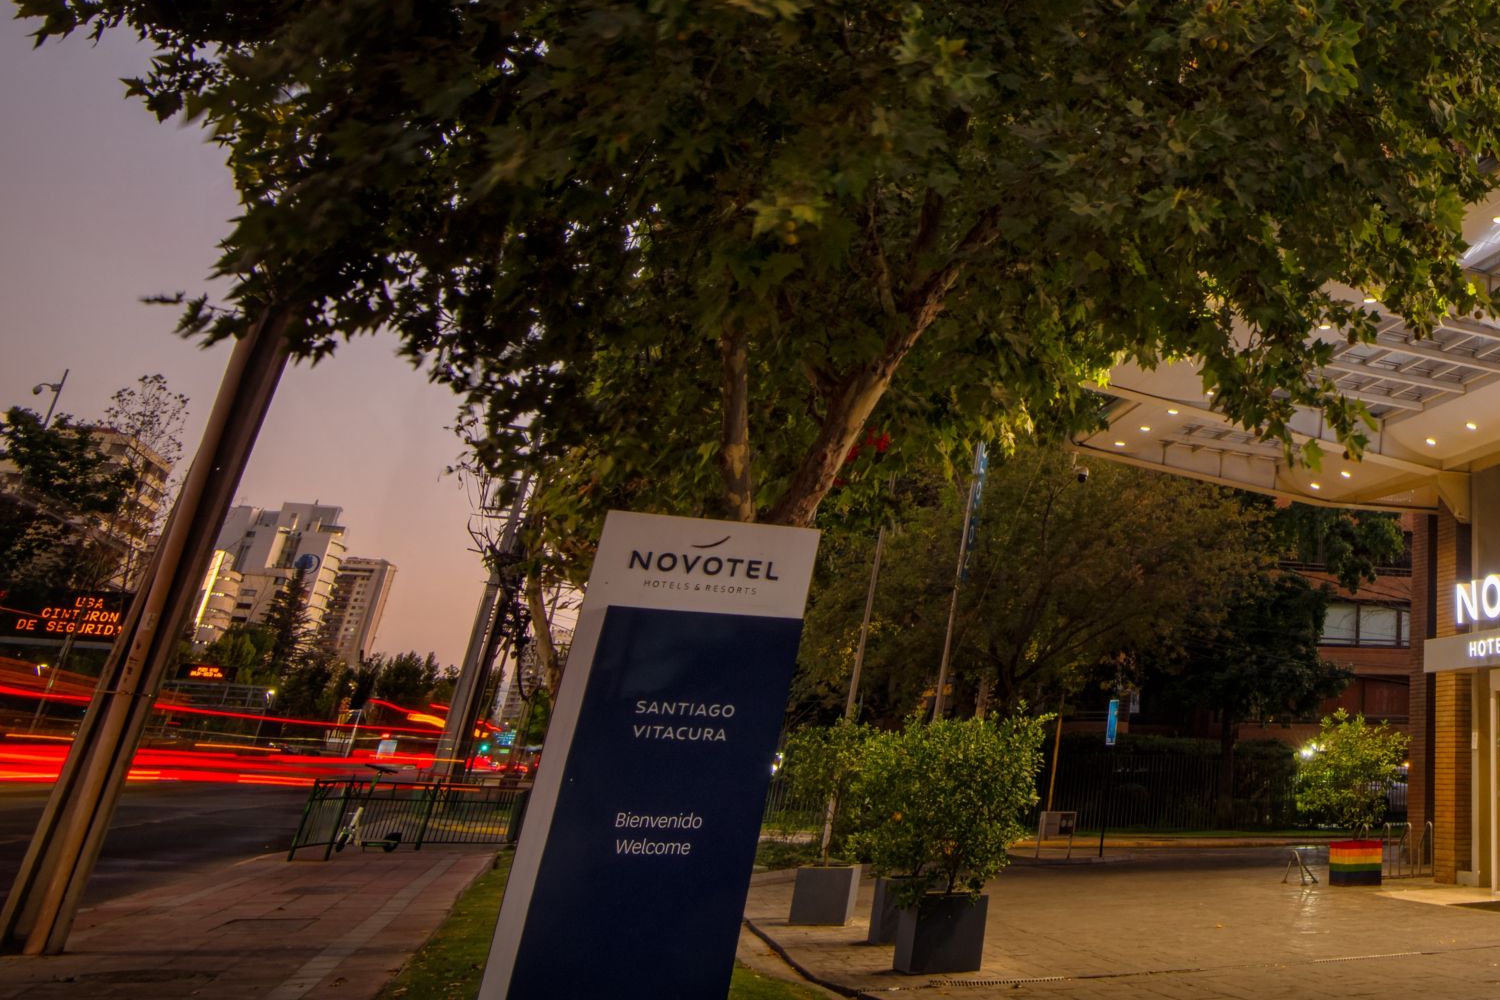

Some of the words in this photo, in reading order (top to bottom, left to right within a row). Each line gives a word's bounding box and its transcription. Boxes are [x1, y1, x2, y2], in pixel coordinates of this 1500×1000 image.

[628, 550, 779, 581] NOVOTEL
[643, 579, 690, 591] HOTELS
[705, 584, 757, 596] RESORTS
[15, 619, 38, 630] DE
[634, 700, 736, 718] SANTIAGO
[633, 724, 727, 742] VITACURA
[615, 811, 703, 829] Bienvenido
[616, 838, 691, 855] Welcome
